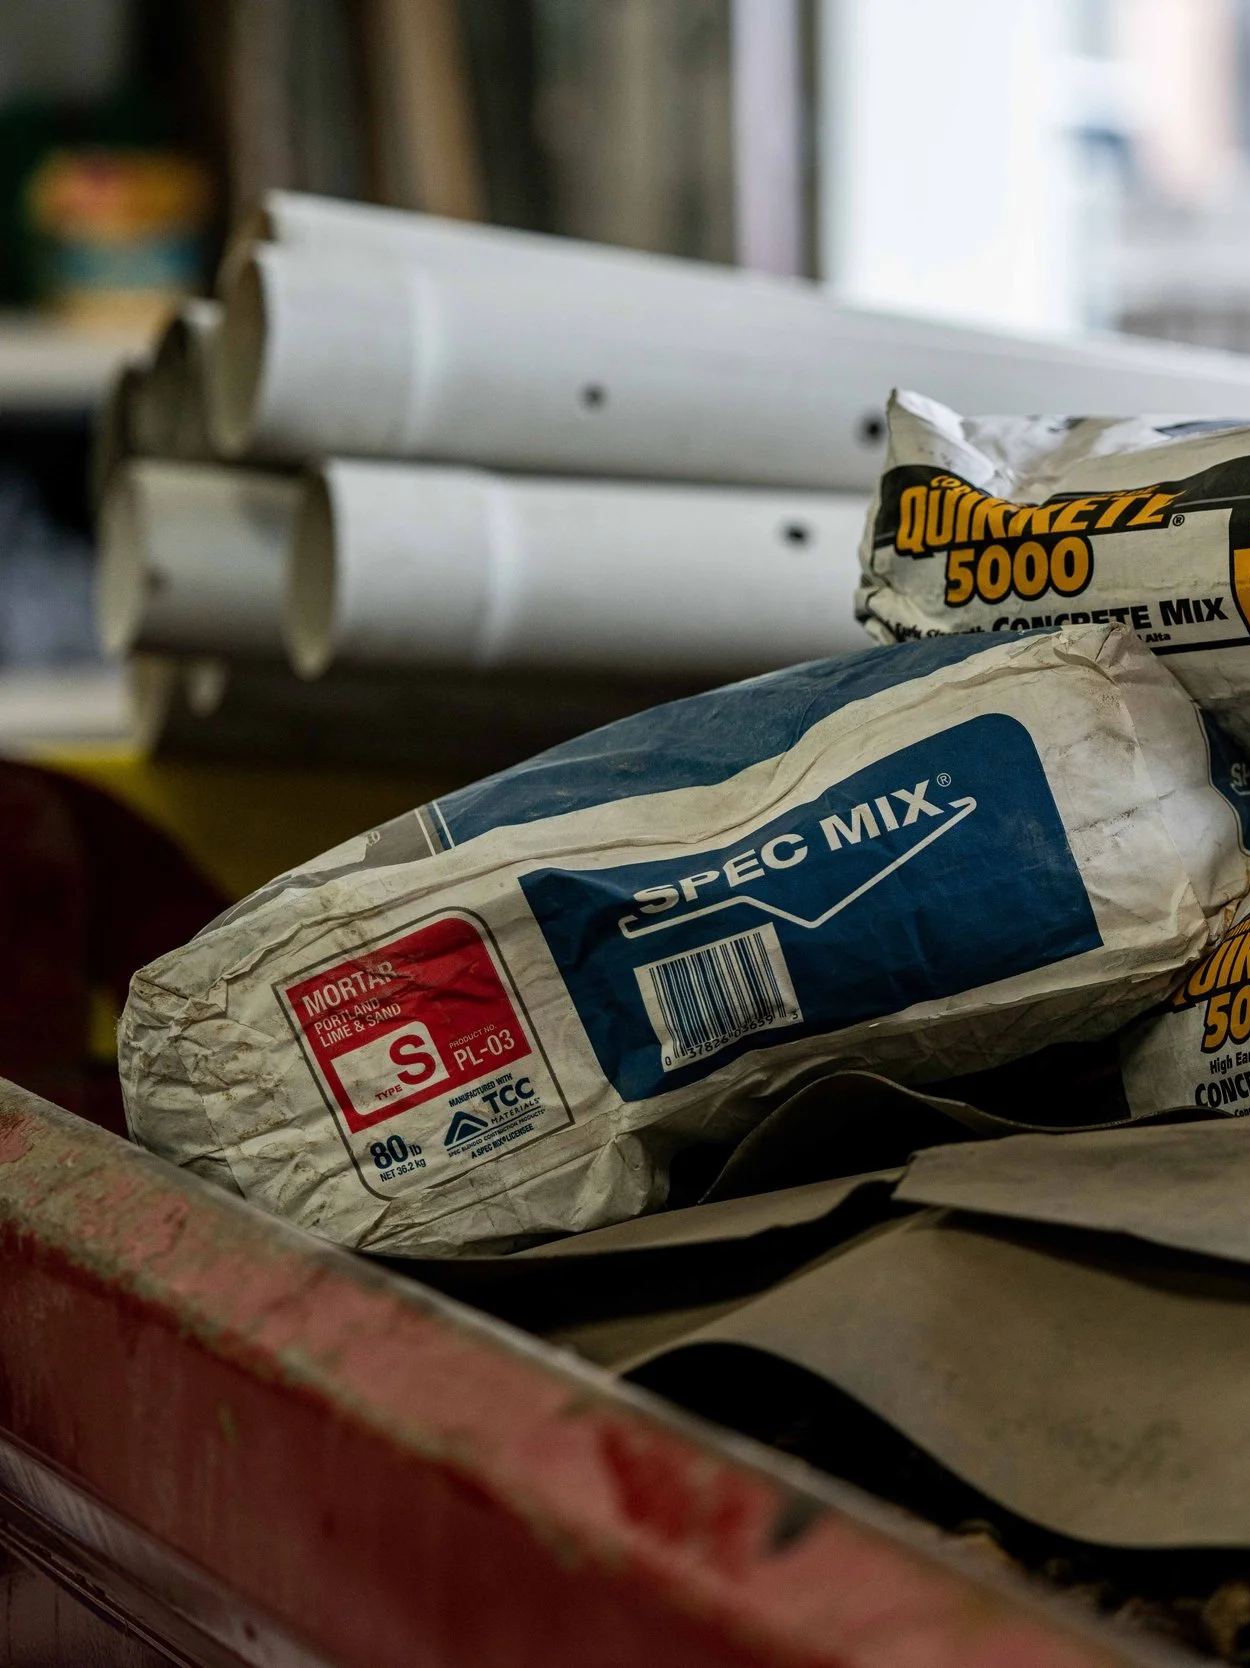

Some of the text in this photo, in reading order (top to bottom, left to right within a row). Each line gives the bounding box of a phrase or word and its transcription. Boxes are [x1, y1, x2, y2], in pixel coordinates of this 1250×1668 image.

[947, 536, 1089, 603] 5000
[1159, 597, 1228, 627] MIX
[1146, 632, 1171, 643] Alta
[633, 834, 808, 914] SPEC
[302, 961, 397, 1017] MORTAR
[314, 997, 380, 1035] PORTLAND
[320, 1003, 401, 1047] LIME & SAND
[449, 1029, 483, 1049] PRODUCT
[453, 1029, 515, 1071] PL-03
[687, 1036, 729, 1058] 37826
[734, 1014, 773, 1038] 03659
[375, 1034, 436, 1101] TYPE S
[1210, 1055, 1233, 1074] High
[449, 1073, 513, 1107] MANUFACTURED WITH
[482, 1077, 535, 1114] TCC
[370, 1134, 408, 1169] 80
[409, 1144, 422, 1157] lb
[471, 1151, 477, 1159] A
[478, 1144, 493, 1156] SPEC
[380, 1158, 426, 1182] NET 36.2 kg
